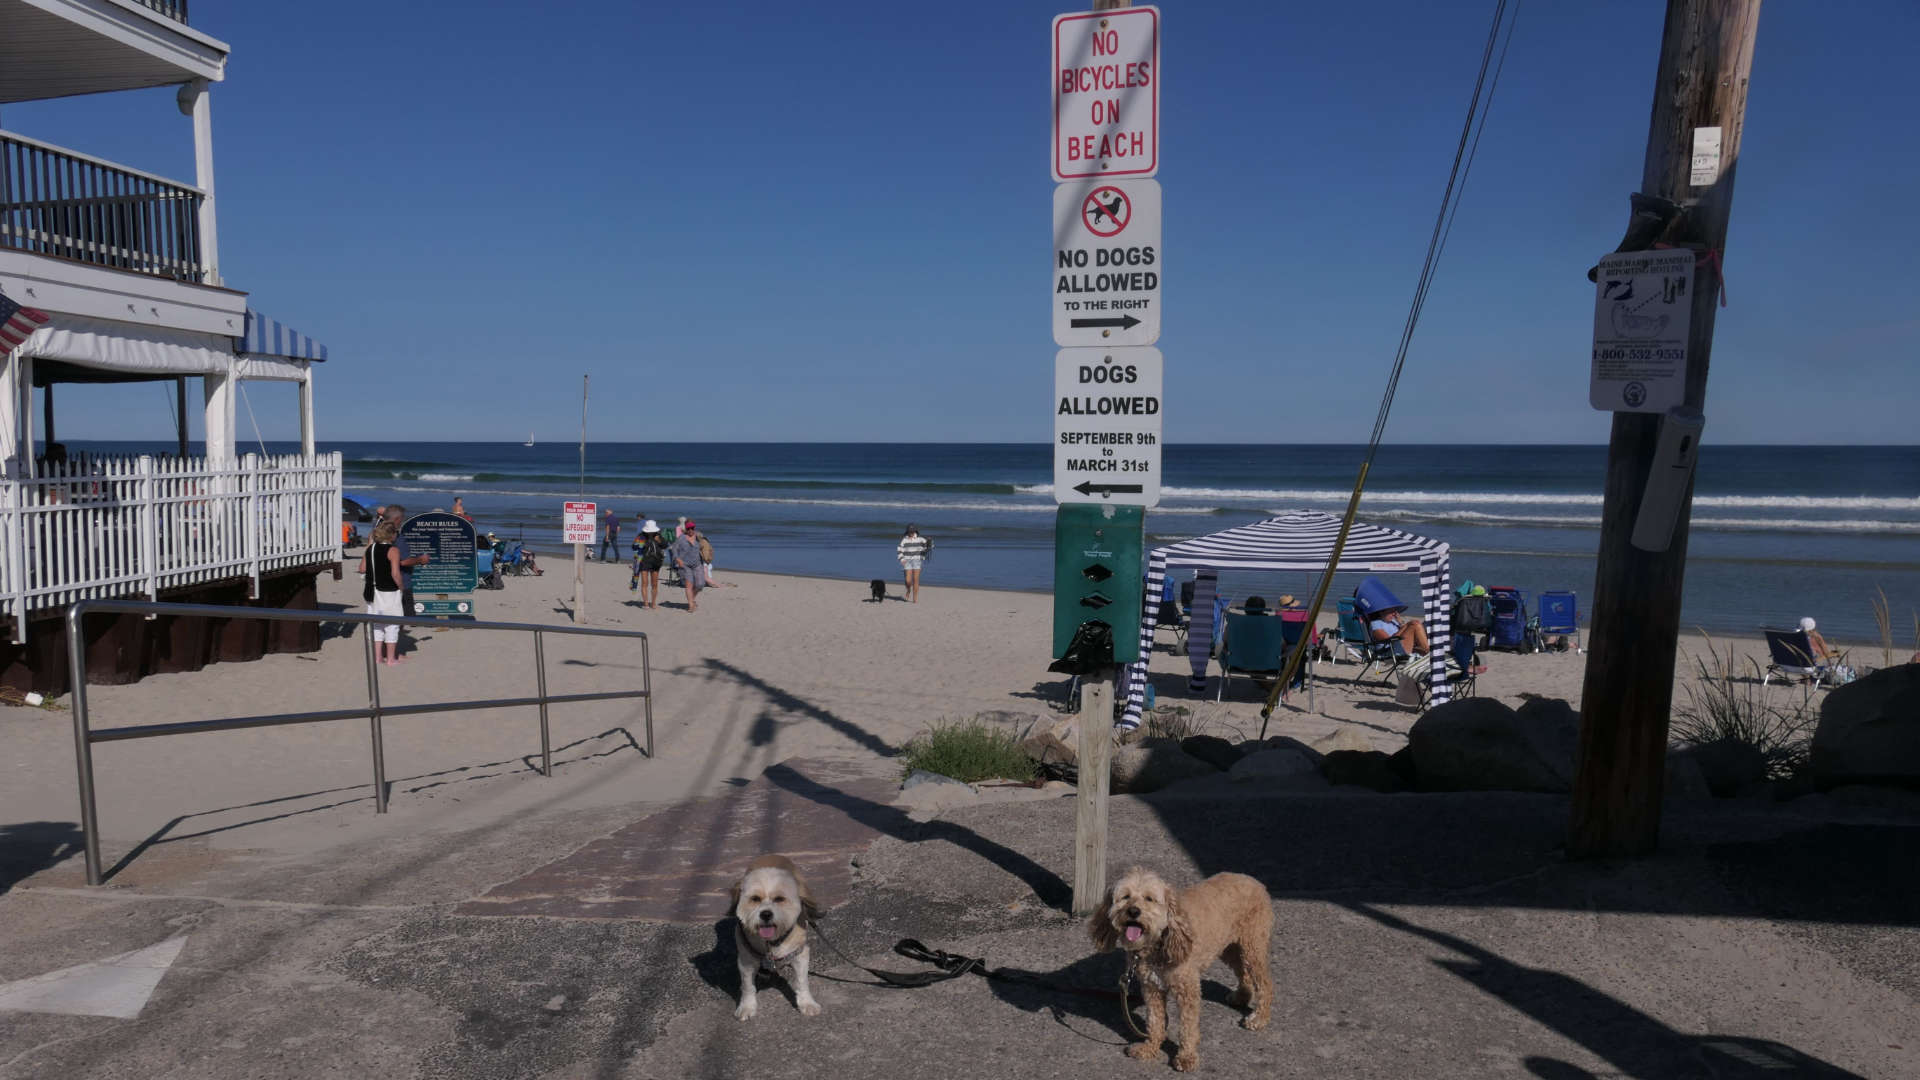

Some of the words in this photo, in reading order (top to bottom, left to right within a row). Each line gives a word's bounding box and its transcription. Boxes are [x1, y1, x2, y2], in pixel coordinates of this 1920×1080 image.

[1092, 30, 1118, 56] NO
[1062, 62, 1150, 93] BICYCLES
[1092, 99, 1119, 125] ON
[1068, 131, 1143, 160] BEACH
[1059, 249, 1088, 268] NO
[1096, 247, 1155, 267] DOGS
[1056, 272, 1158, 293] ALLOWED
[1064, 301, 1080, 311] TO
[1083, 301, 1107, 310] THE
[1111, 299, 1150, 310] RIGHT
[1079, 365, 1137, 384] DOGS
[1058, 397, 1159, 415] ALLOWED
[1060, 432, 1133, 445] SEPTEMBER
[1137, 432, 1156, 445] 9th
[1102, 447, 1113, 457] to
[1067, 459, 1117, 472] MARCH
[1121, 459, 1149, 472] 31st
[569, 533, 576, 541] ON
[577, 533, 591, 541] DUTY
